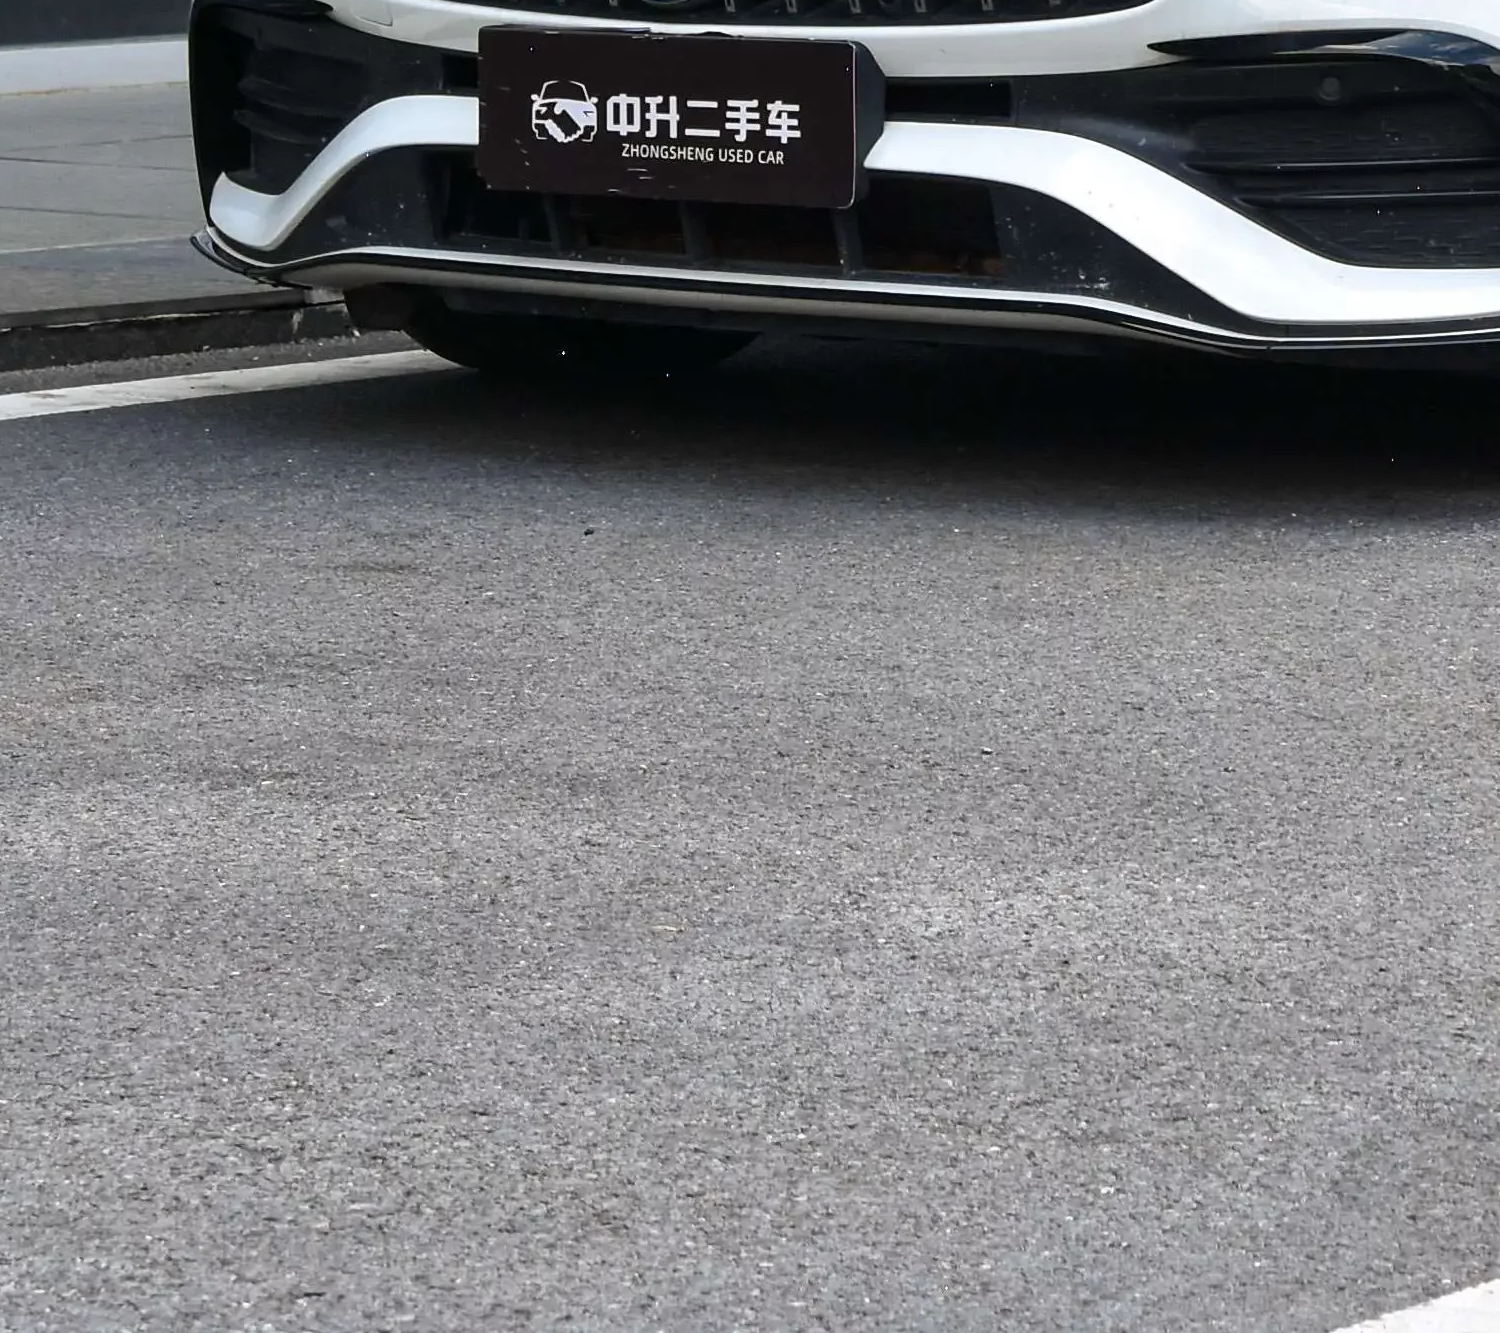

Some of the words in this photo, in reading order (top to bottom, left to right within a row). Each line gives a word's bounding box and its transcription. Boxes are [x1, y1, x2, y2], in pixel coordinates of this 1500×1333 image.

[606, 93, 801, 144] 中升二手车
[621, 143, 714, 163] ZHONGSHENG
[718, 148, 754, 164] USED
[757, 150, 785, 165] CAR
